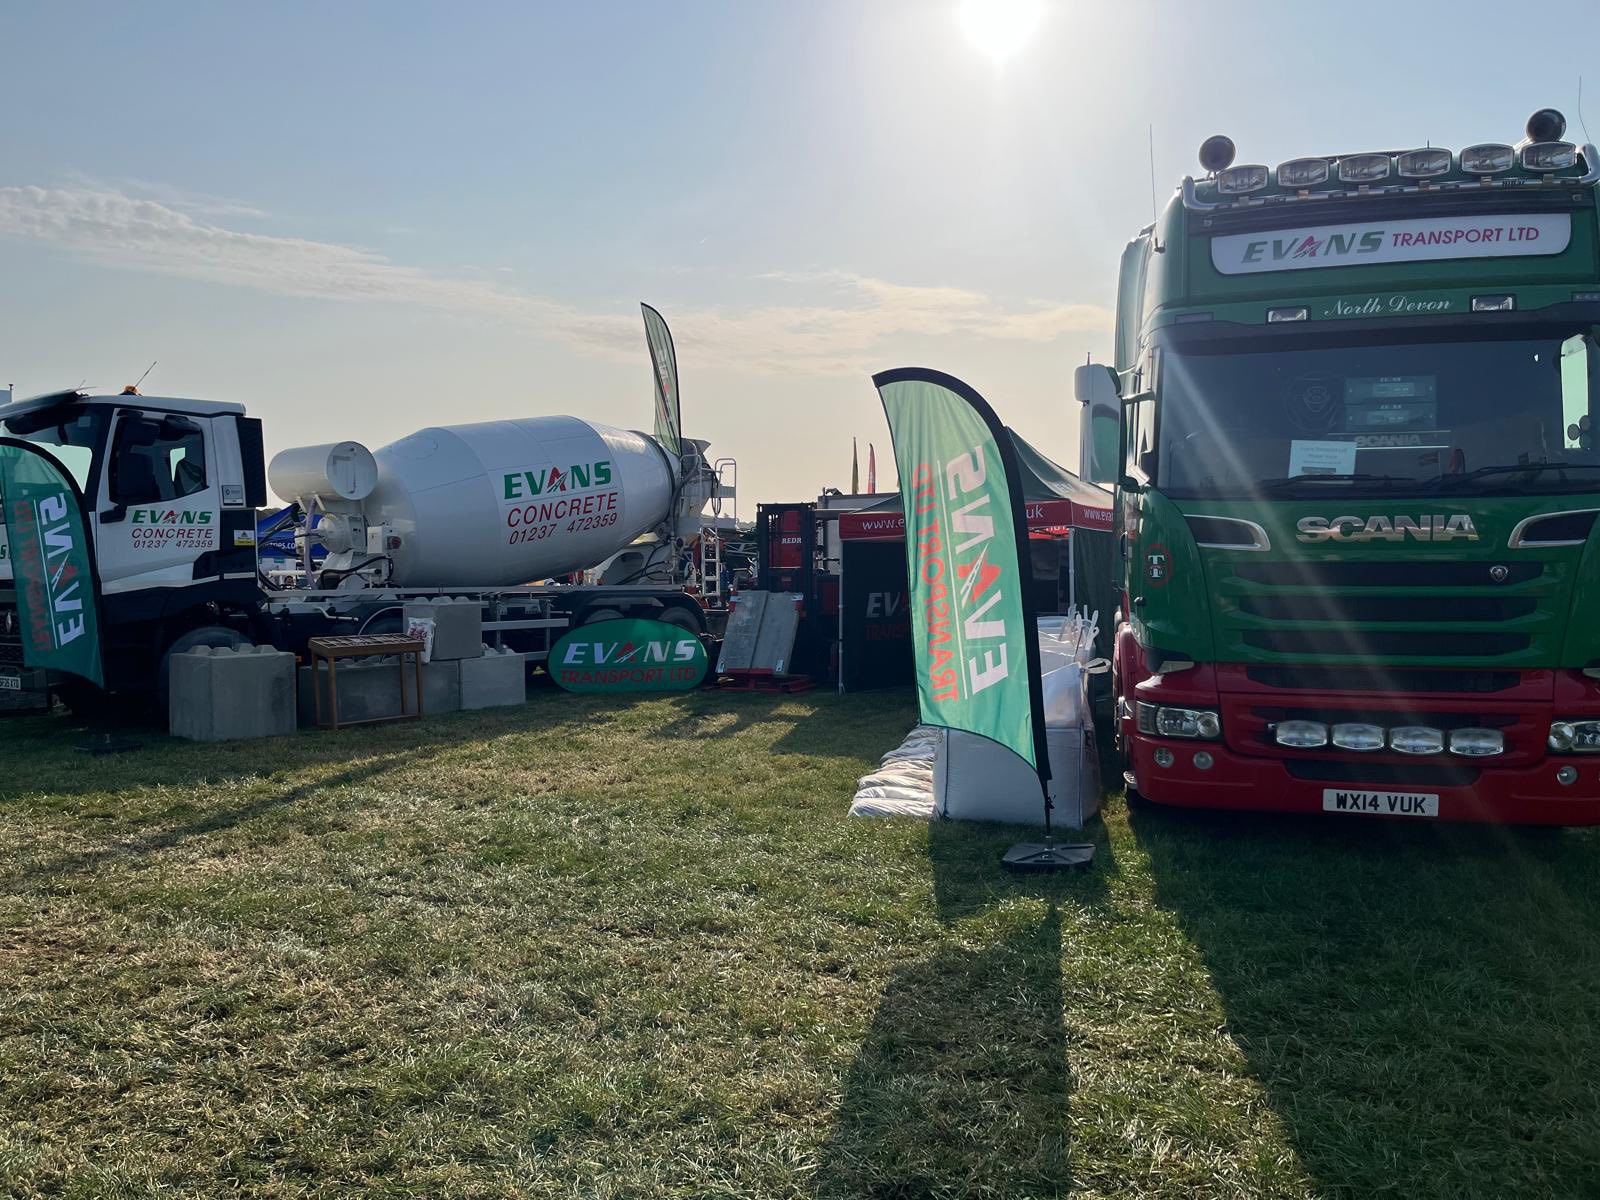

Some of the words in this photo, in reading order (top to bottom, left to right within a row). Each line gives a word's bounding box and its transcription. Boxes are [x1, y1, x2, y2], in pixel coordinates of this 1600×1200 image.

[1241, 230, 1385, 264] EVANS
[1392, 227, 1503, 247] TRANSPORT
[1508, 226, 1540, 242] LTD
[1324, 298, 1386, 316] North
[1388, 295, 1451, 312] Devon
[504, 460, 612, 500] EVANS
[132, 509, 212, 524] EVANS
[507, 492, 618, 528] CONCRETE
[132, 528, 214, 539] CONCRETE
[509, 523, 558, 545] 01237
[566, 512, 618, 534] 472359
[1295, 514, 1480, 543] SCANIA
[133, 540, 168, 549] 01237
[176, 540, 213, 548] 472359
[562, 639, 697, 664] EVANS
[560, 667, 665, 685] TRANSPORT
[670, 666, 697, 682] LTD
[1336, 793, 1380, 811] WX14
[1387, 795, 1427, 814] VUK
